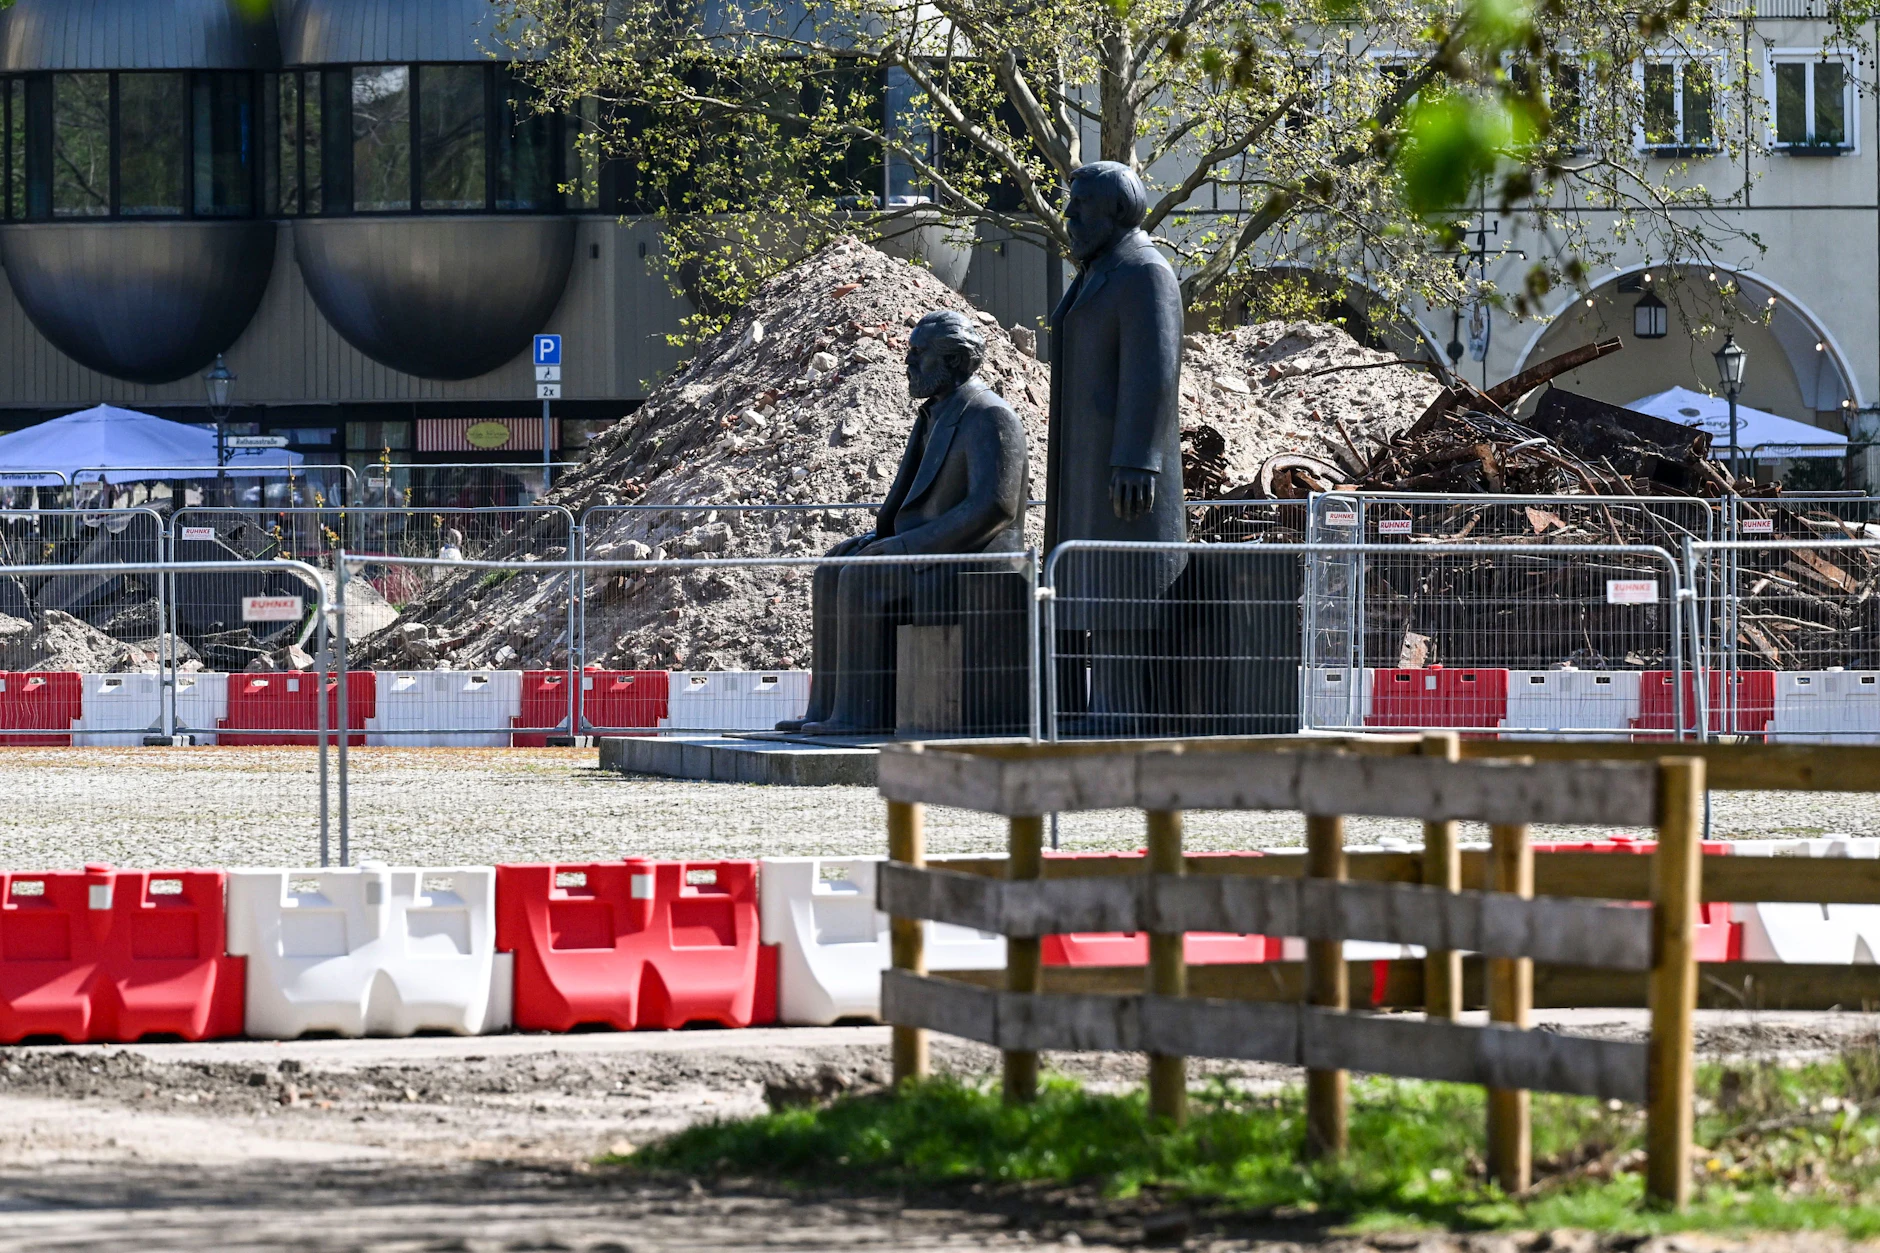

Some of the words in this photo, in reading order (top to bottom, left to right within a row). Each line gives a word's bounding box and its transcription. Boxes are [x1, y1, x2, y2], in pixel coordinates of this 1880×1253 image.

[540, 338, 555, 361] P
[543, 386, 554, 396] 2x
[1380, 521, 1410, 529] RUHNKE
[1743, 520, 1771, 528] RUHNKE
[1613, 583, 1652, 591] RUHNKE
[251, 599, 295, 608] RUHNKE
